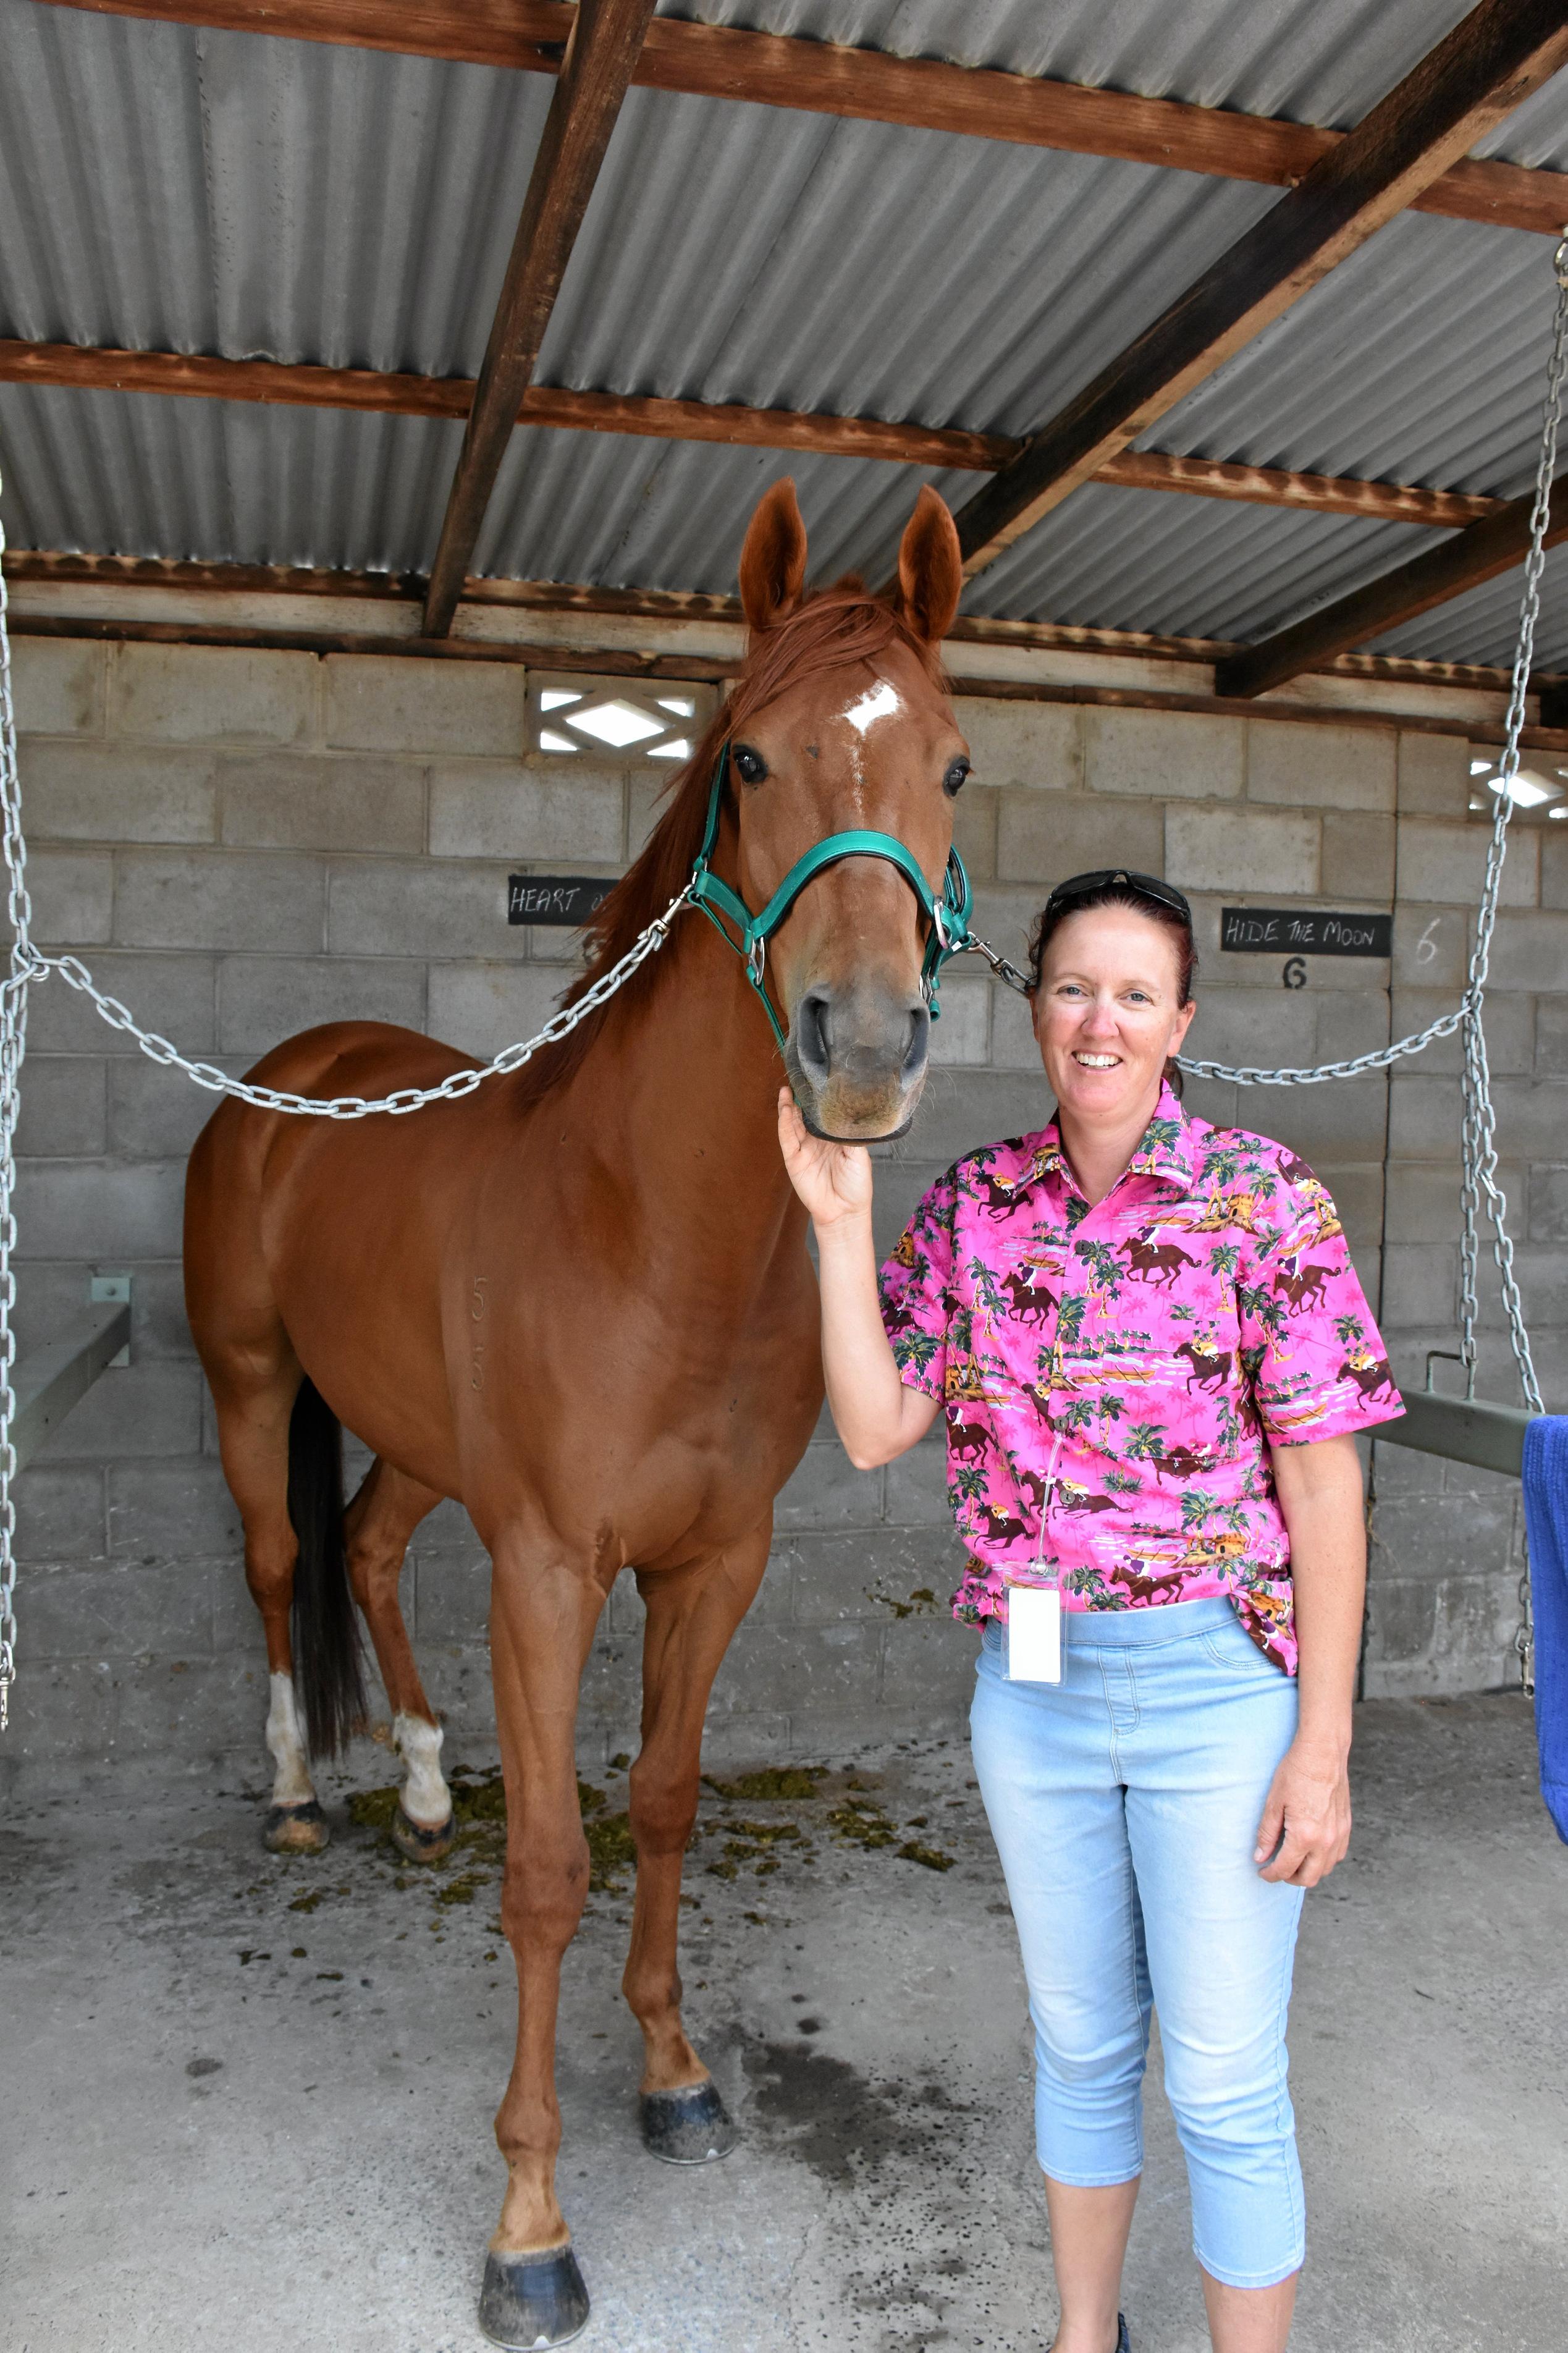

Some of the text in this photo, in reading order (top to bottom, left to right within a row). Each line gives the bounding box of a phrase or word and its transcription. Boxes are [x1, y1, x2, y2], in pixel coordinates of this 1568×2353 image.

[510, 887, 581, 913] HEART
[1226, 916, 1375, 946] HIDE THE MOON
[1415, 918, 1441, 965] 6
[1283, 957, 1307, 989] 6
[471, 1275, 488, 1322] 5
